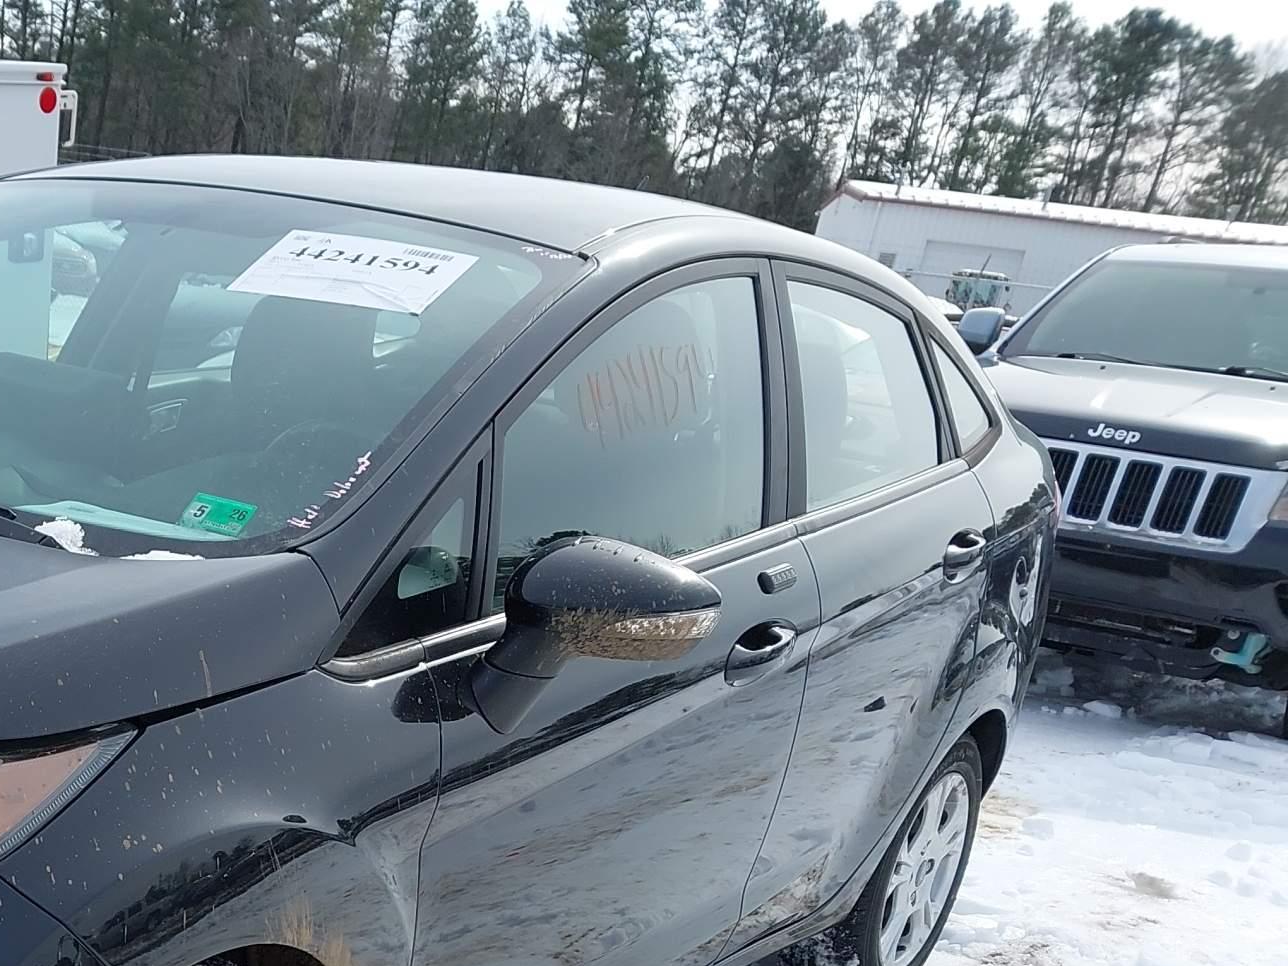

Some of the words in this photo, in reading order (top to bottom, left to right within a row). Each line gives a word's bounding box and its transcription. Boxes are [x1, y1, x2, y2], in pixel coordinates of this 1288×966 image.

[288, 245, 440, 275] 44241594
[1087, 423, 1141, 445] Jeep
[192, 504, 209, 518] 5
[230, 508, 249, 521] 26
